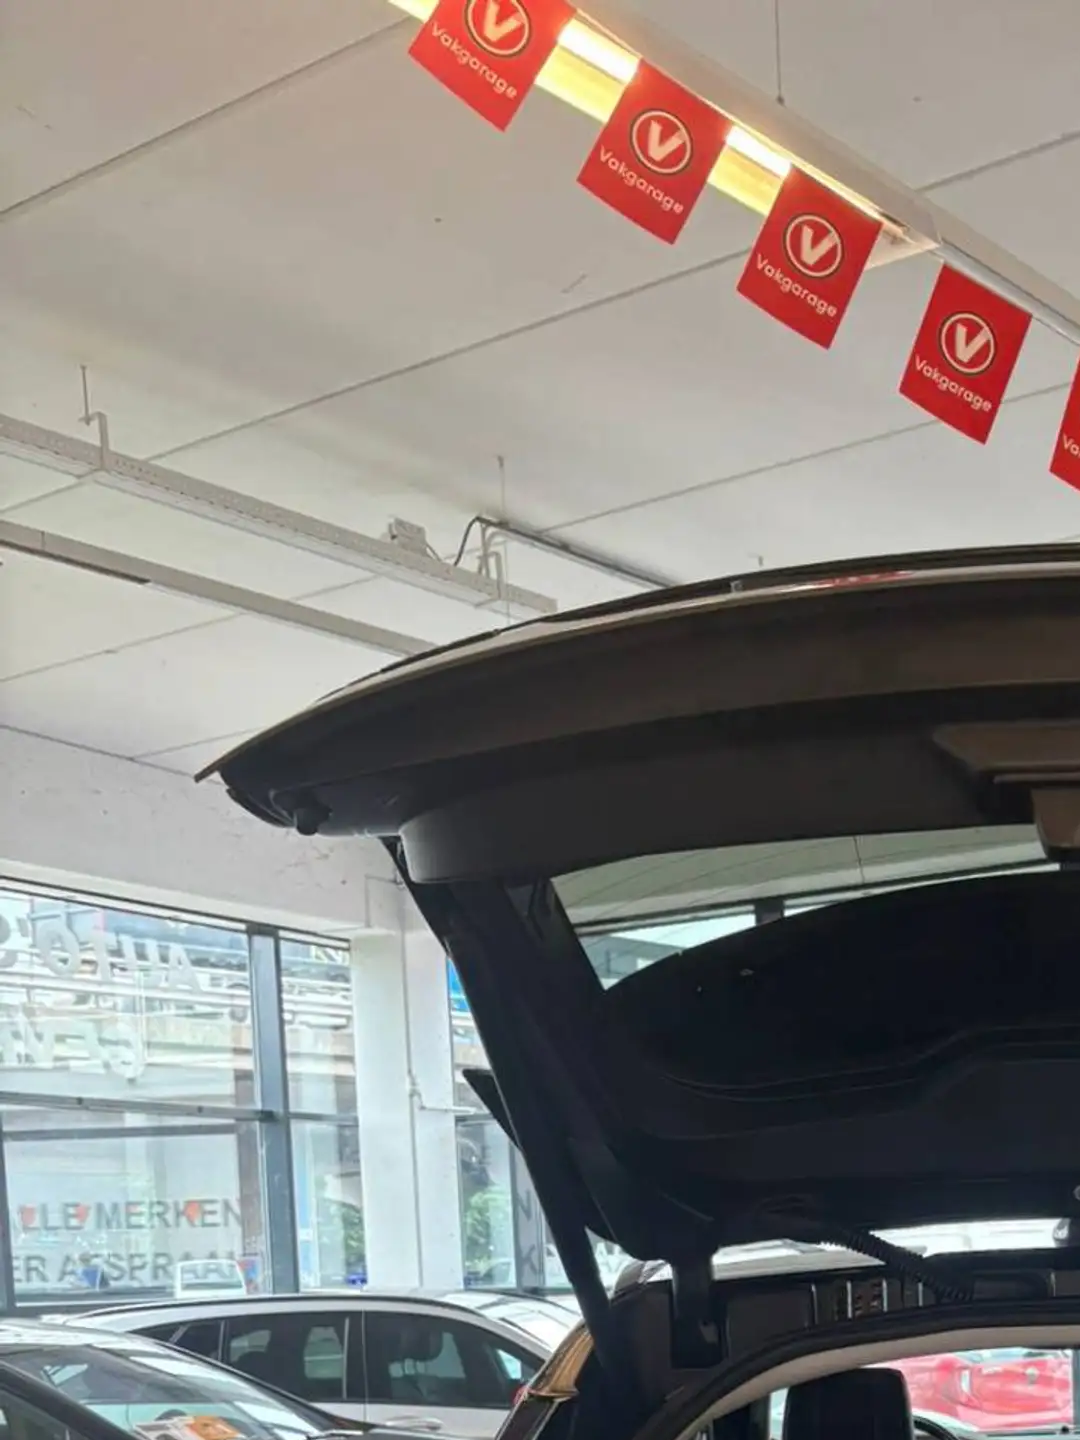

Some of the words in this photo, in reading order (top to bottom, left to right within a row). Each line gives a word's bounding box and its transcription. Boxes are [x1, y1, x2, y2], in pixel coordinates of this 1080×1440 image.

[432, 22, 517, 99] Vakgarage
[600, 146, 684, 214] Vakgarage
[756, 253, 838, 318] Vakgarage
[914, 354, 992, 412] Vakgarage
